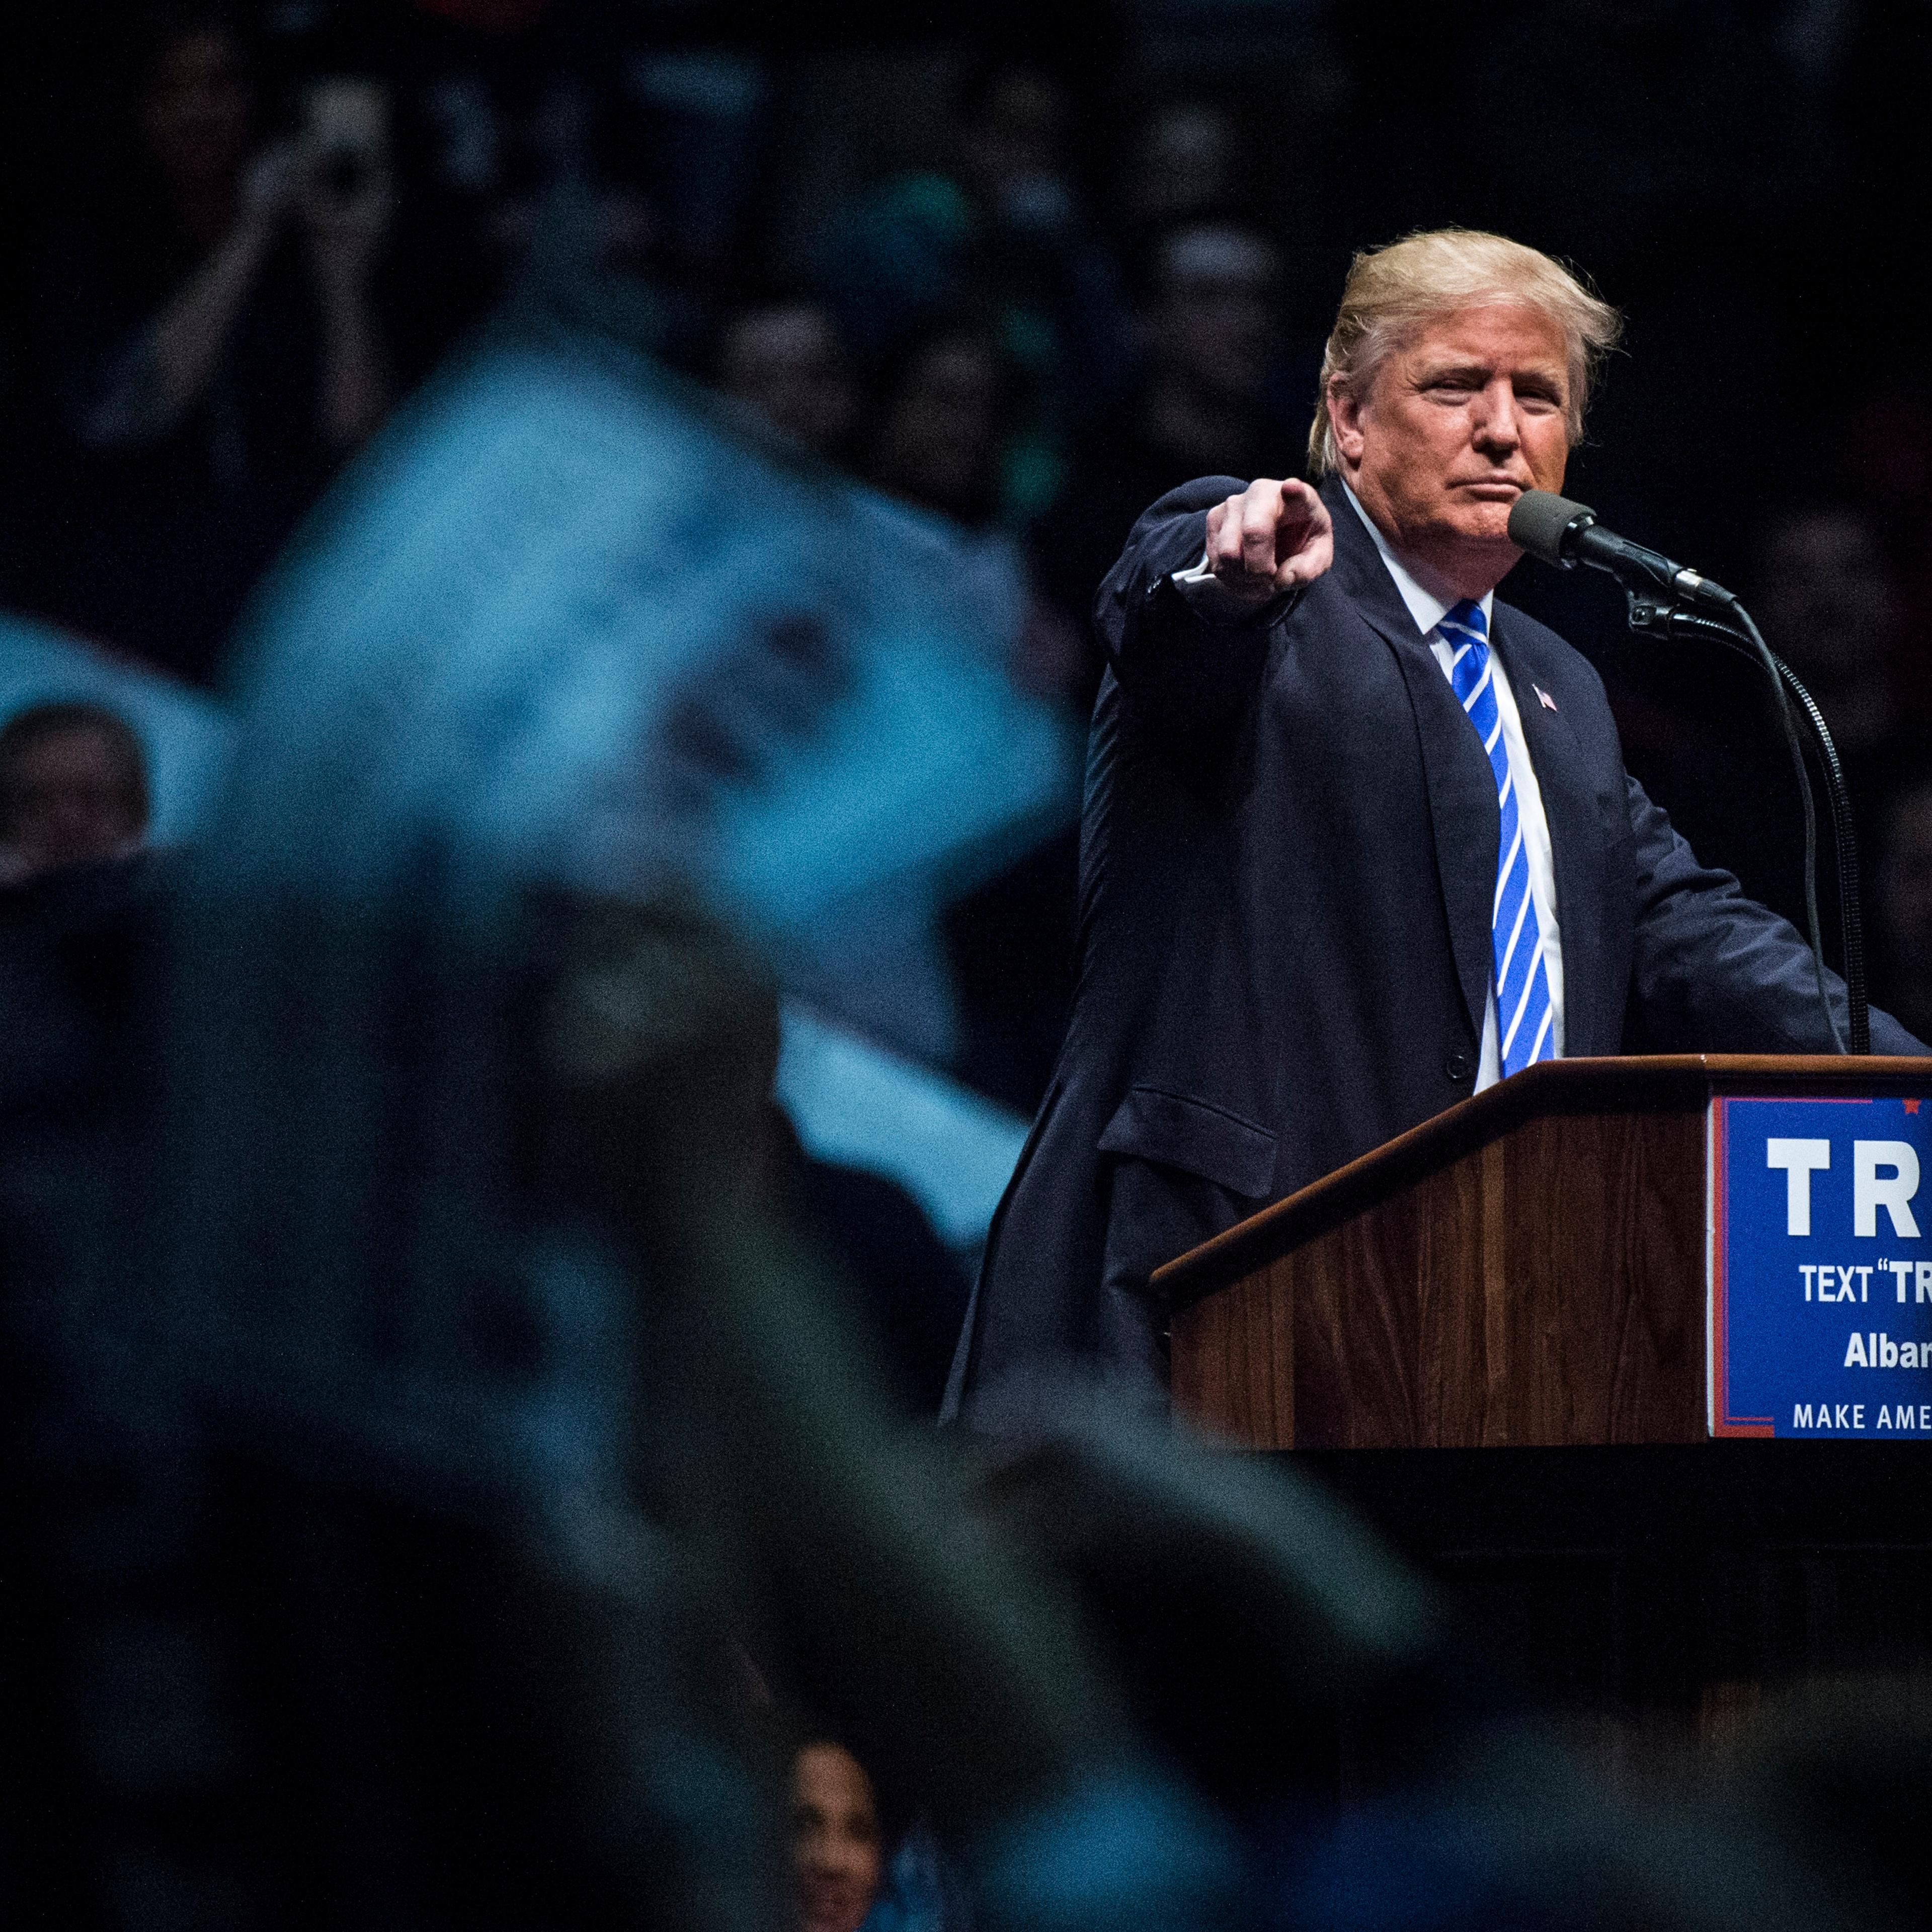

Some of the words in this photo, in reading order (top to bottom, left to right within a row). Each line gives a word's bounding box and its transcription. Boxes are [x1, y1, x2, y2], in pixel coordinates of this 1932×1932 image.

[1766, 1138, 1922, 1238] TR
[1798, 1264, 1874, 1303] TEXT
[1793, 1404, 1865, 1429] MAKE
[1877, 1405, 1932, 1429] AME
